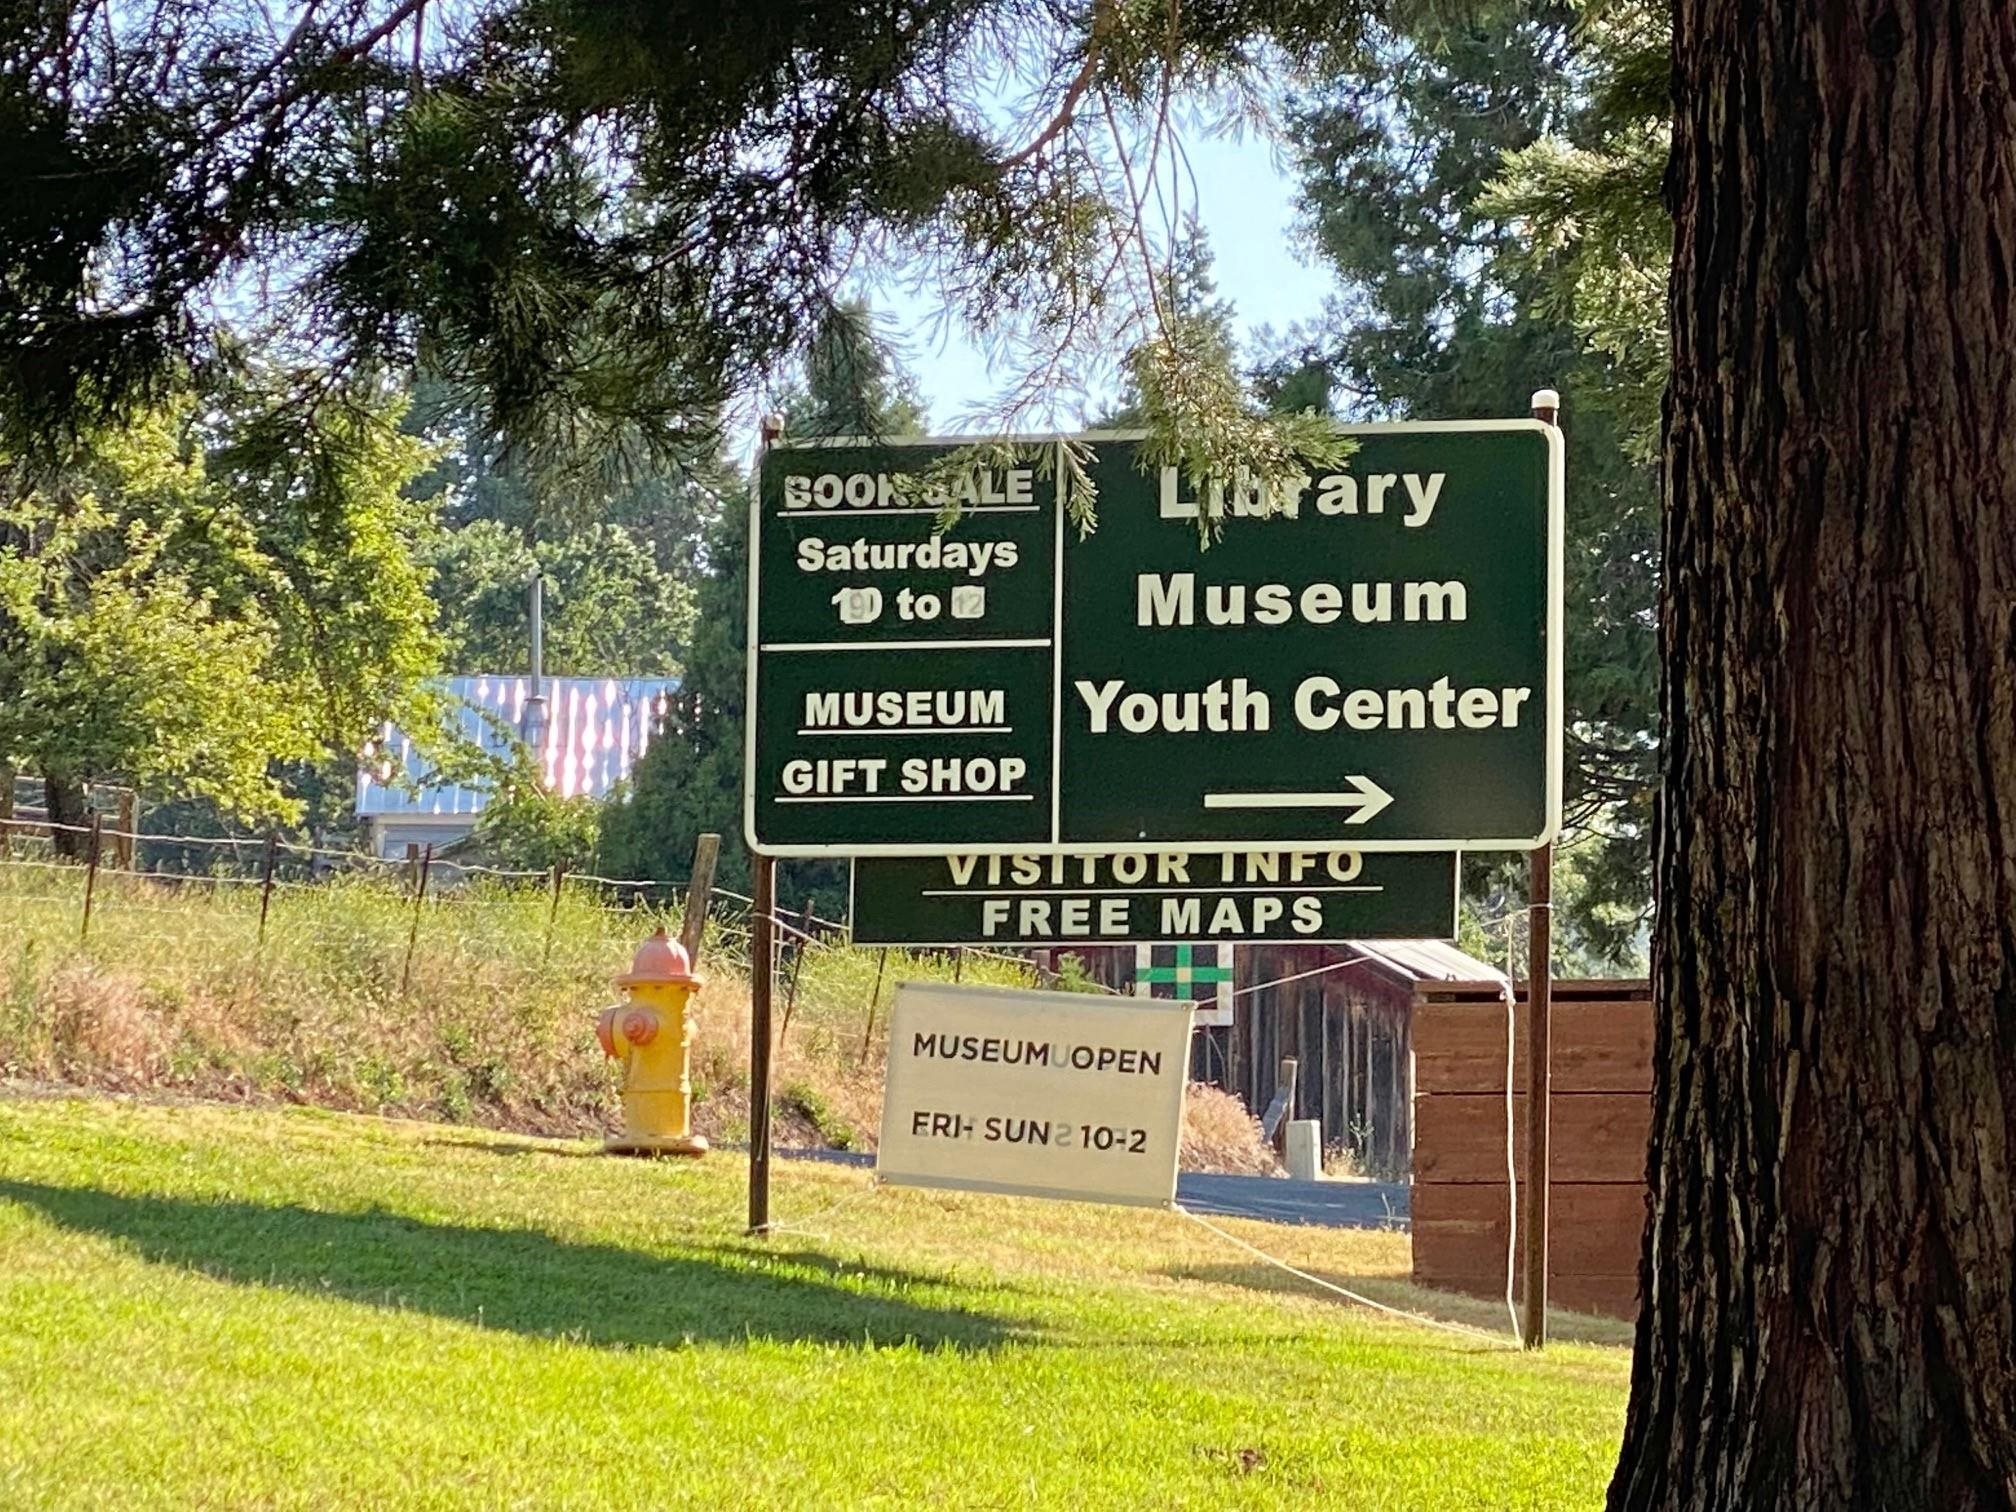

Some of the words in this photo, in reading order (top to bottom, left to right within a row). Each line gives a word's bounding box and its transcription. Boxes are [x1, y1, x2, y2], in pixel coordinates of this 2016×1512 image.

[784, 473, 909, 508] BOOK
[920, 468, 1034, 505] ALE
[797, 535, 1019, 577] Saturdays
[896, 587, 942, 621] to
[1137, 573, 1468, 627] Museum
[805, 690, 1005, 726] MUSEUM
[1074, 678, 1270, 734] Youth
[1294, 675, 1532, 731] Center
[782, 758, 887, 794] GIFT
[901, 757, 1027, 793] SHOP
[946, 852, 1191, 886] VISITOR
[1221, 850, 1364, 883] INFO
[982, 898, 1130, 936] FREE
[1160, 896, 1324, 935] MAPS
[913, 1032, 1050, 1067] MUSEUM
[1071, 1046, 1162, 1075] OPEN
[984, 1117, 1050, 1146] SUN
[1080, 1124, 1148, 1154] 10-2
